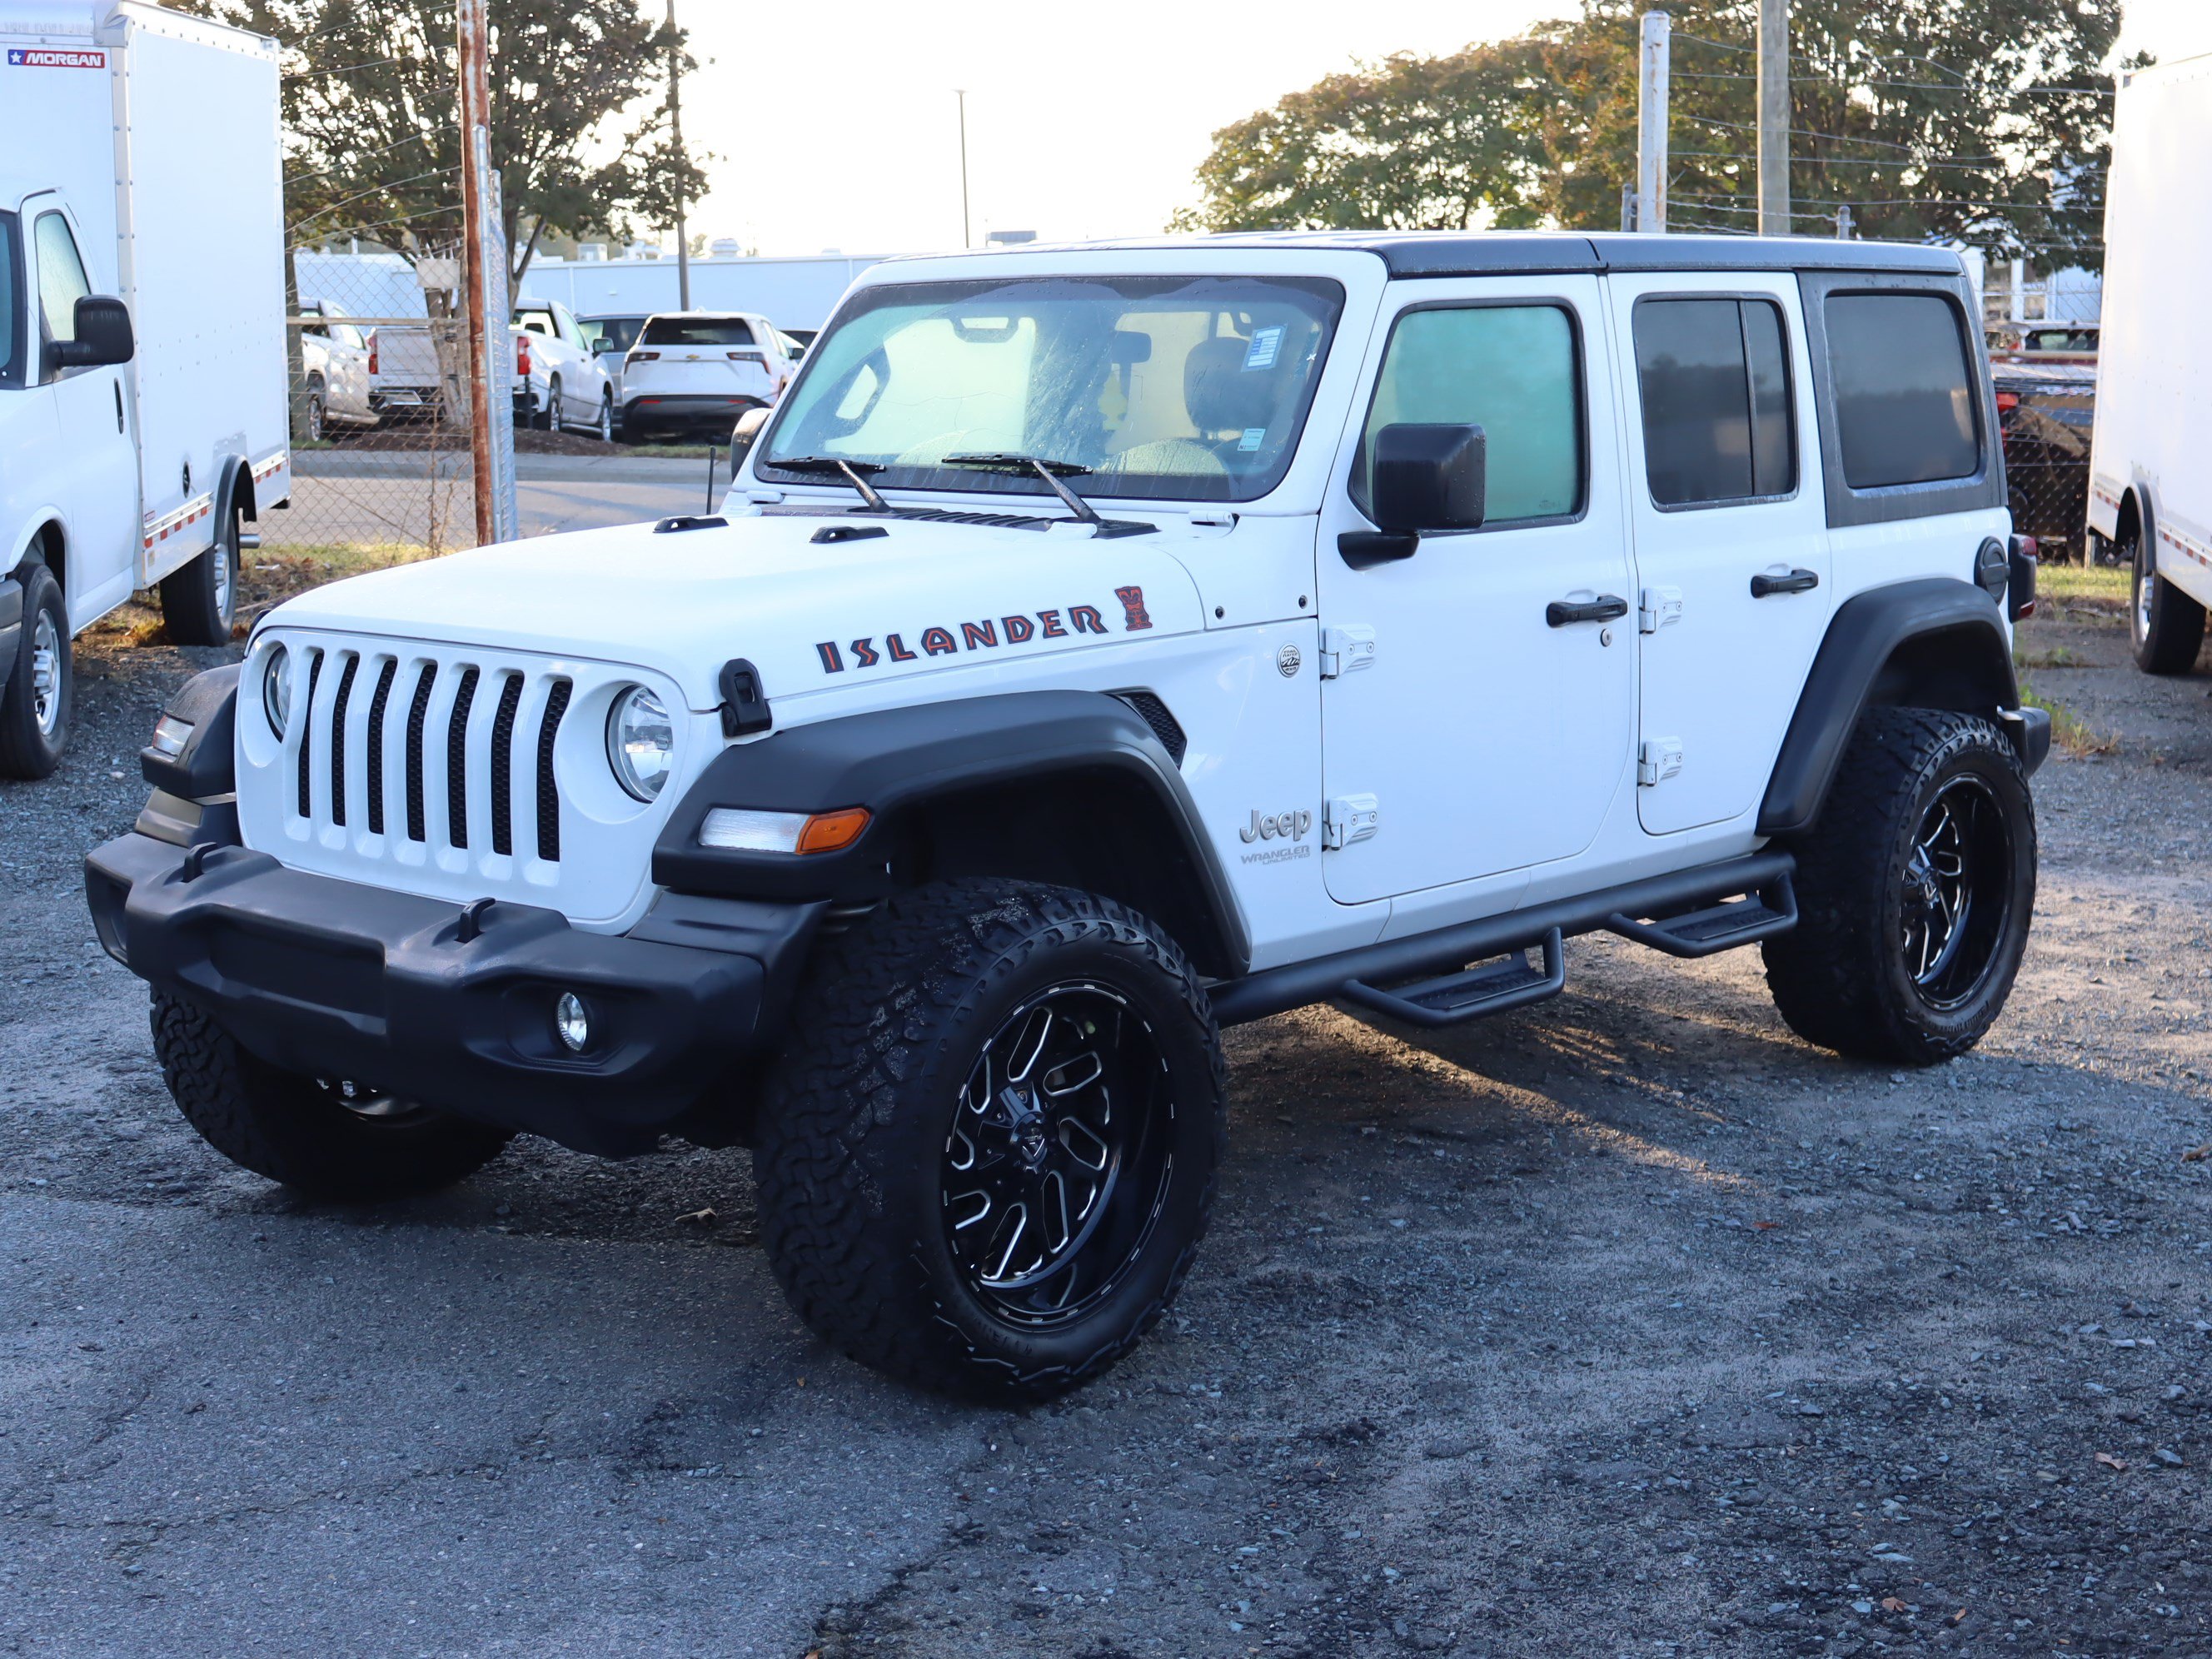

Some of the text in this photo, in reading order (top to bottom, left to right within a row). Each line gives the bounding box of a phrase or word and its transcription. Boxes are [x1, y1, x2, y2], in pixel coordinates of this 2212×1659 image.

[26, 52, 102, 67] MORGAN
[815, 605, 1109, 674] ISLANDER
[1239, 808, 1312, 844] Jeep
[1240, 845, 1310, 864] WRANGLER
[1263, 853, 1310, 865] UNLIMITED
